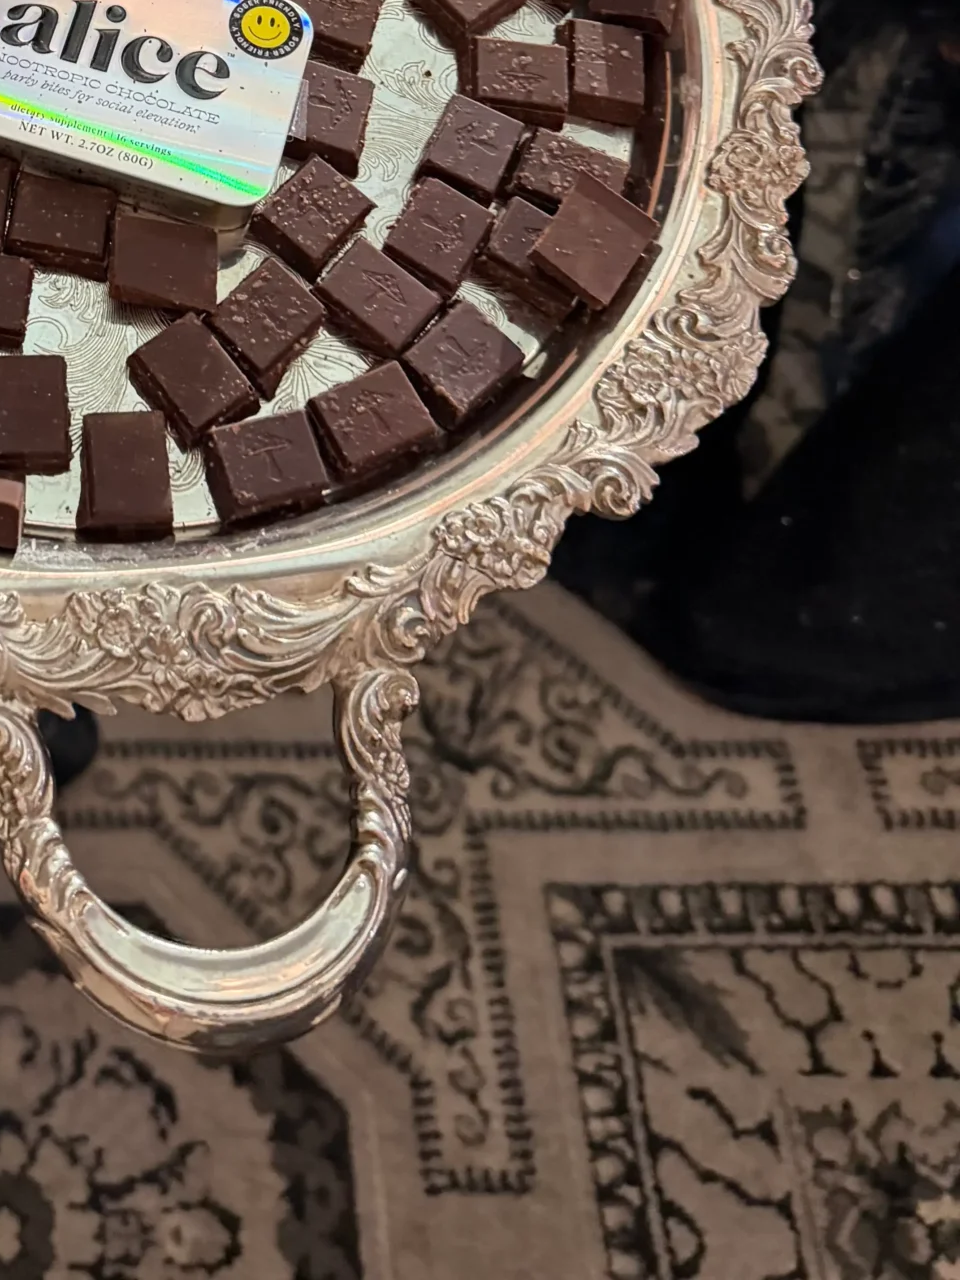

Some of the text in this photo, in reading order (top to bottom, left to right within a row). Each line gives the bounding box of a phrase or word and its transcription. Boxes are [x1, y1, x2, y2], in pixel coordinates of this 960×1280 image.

[0, 0, 230, 100] alice
[231, 26, 299, 57] SOBER FRIENDLY
[2, 70, 38, 87] party
[41, 80, 71, 96] bites
[69, 90, 94, 102] for
[95, 97, 134, 114] social
[105, 83, 221, 125] CHOCOLATE
[10, 104, 46, 120] dietary
[50, 116, 108, 138] supplement
[130, 138, 172, 156] servings
[19, 121, 47, 136] NET
[51, 130, 76, 146] WT.
[117, 150, 154, 170] (80G)
